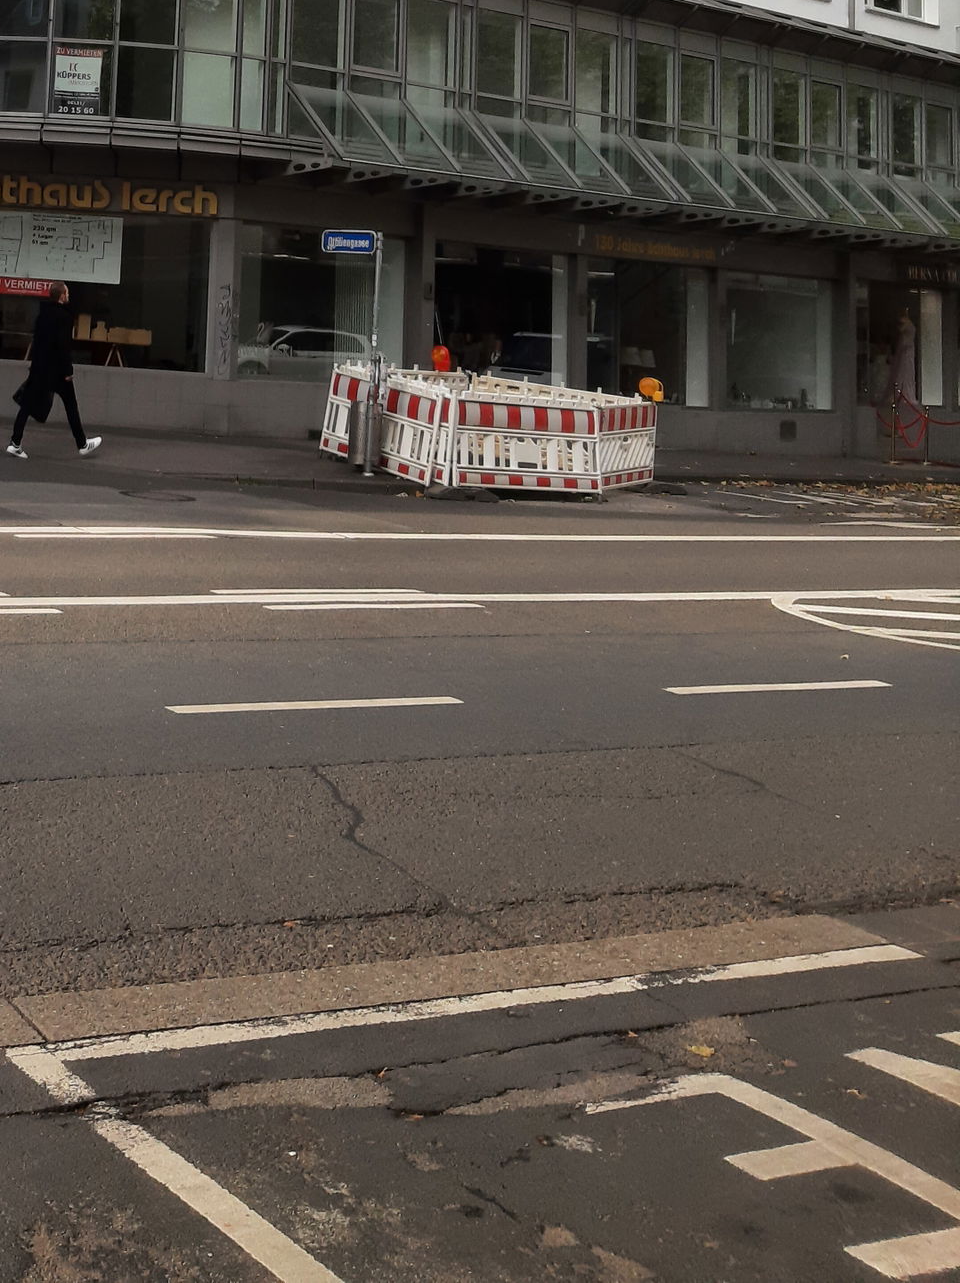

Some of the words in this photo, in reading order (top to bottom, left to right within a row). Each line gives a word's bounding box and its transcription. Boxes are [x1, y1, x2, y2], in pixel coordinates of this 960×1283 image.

[57, 71, 91, 80] KÜPPERS
[57, 105, 69, 113] 20
[71, 106, 81, 114] 15
[122, 181, 218, 215] lerch
[4, 279, 53, 291] VERMIET
